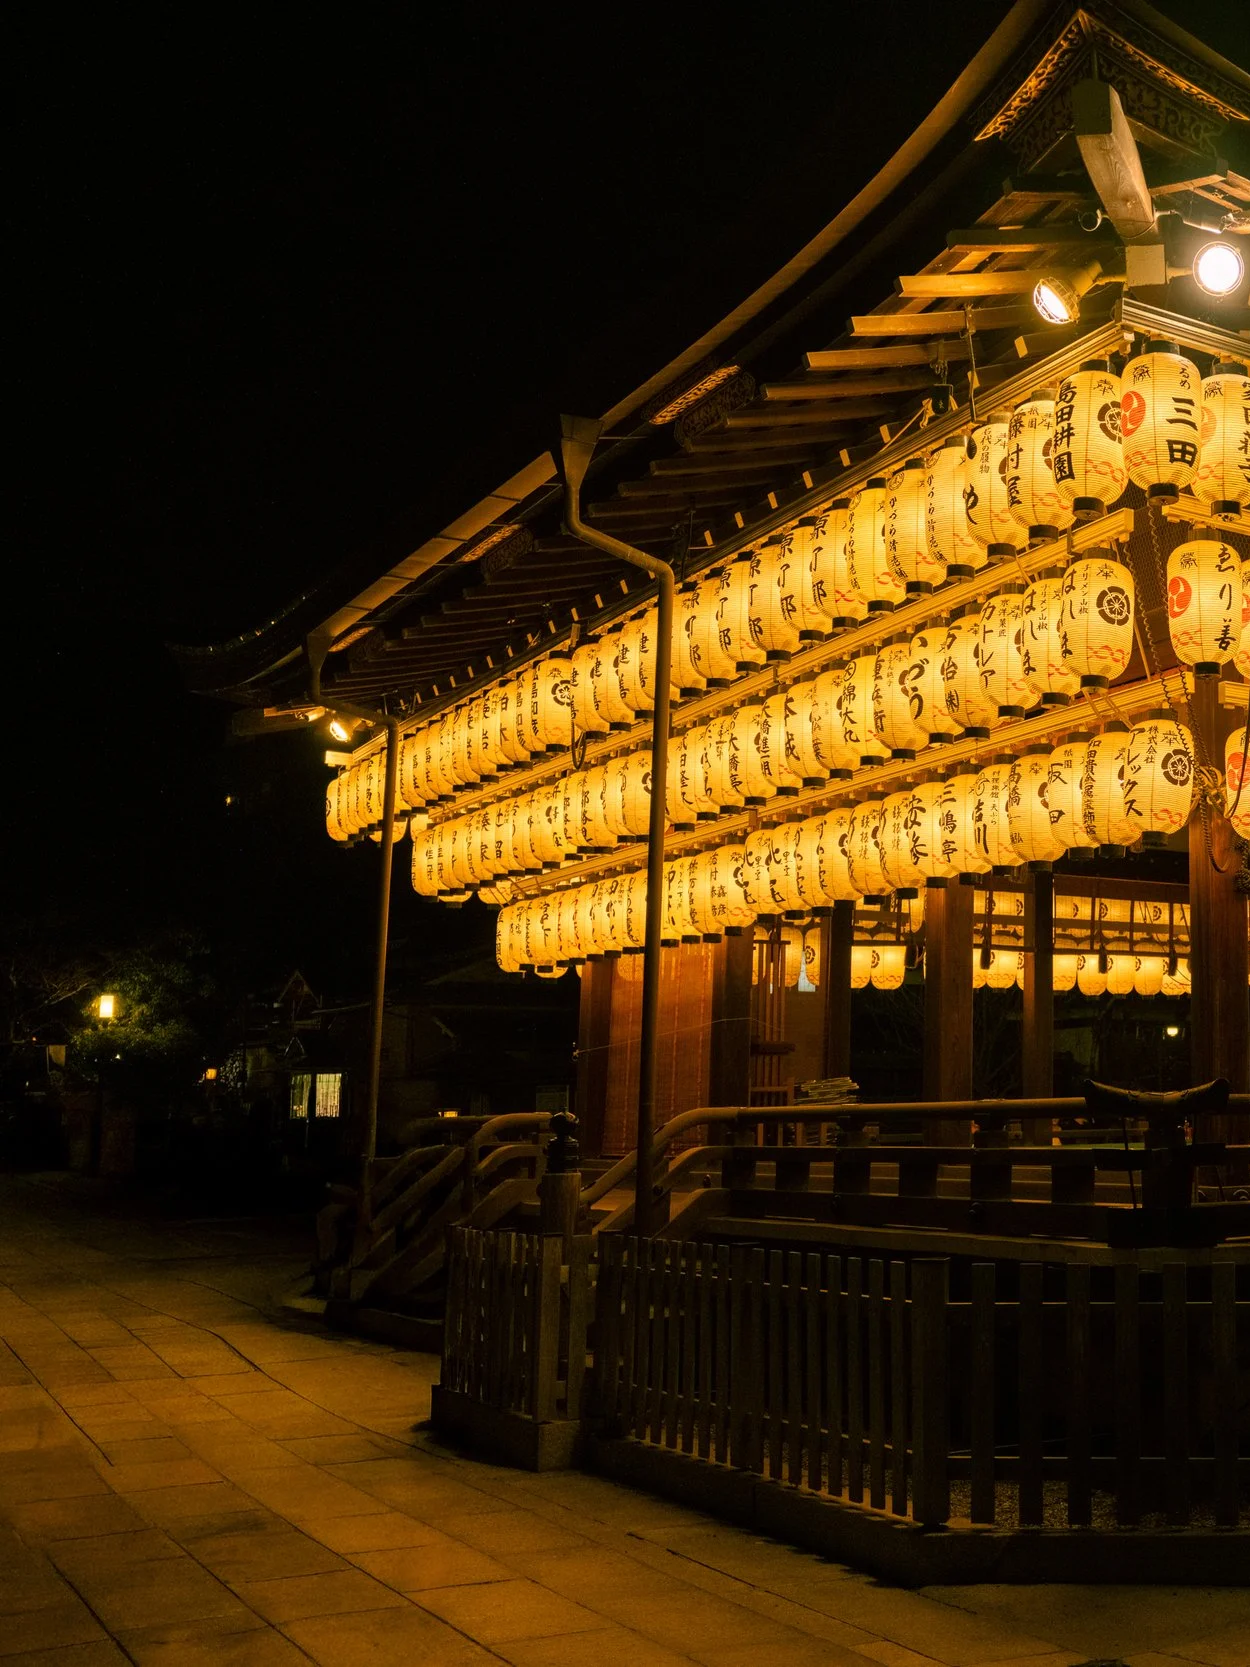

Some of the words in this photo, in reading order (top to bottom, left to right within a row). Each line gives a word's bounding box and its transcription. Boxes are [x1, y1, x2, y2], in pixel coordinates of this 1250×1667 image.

[1054, 381, 1077, 483] 島田耕園
[1166, 396, 1198, 468] 三田
[1214, 543, 1237, 651] ゑり善
[980, 602, 996, 688] カトレア
[1124, 727, 1146, 817] アレックス
[1144, 726, 1159, 764] 株式会社
